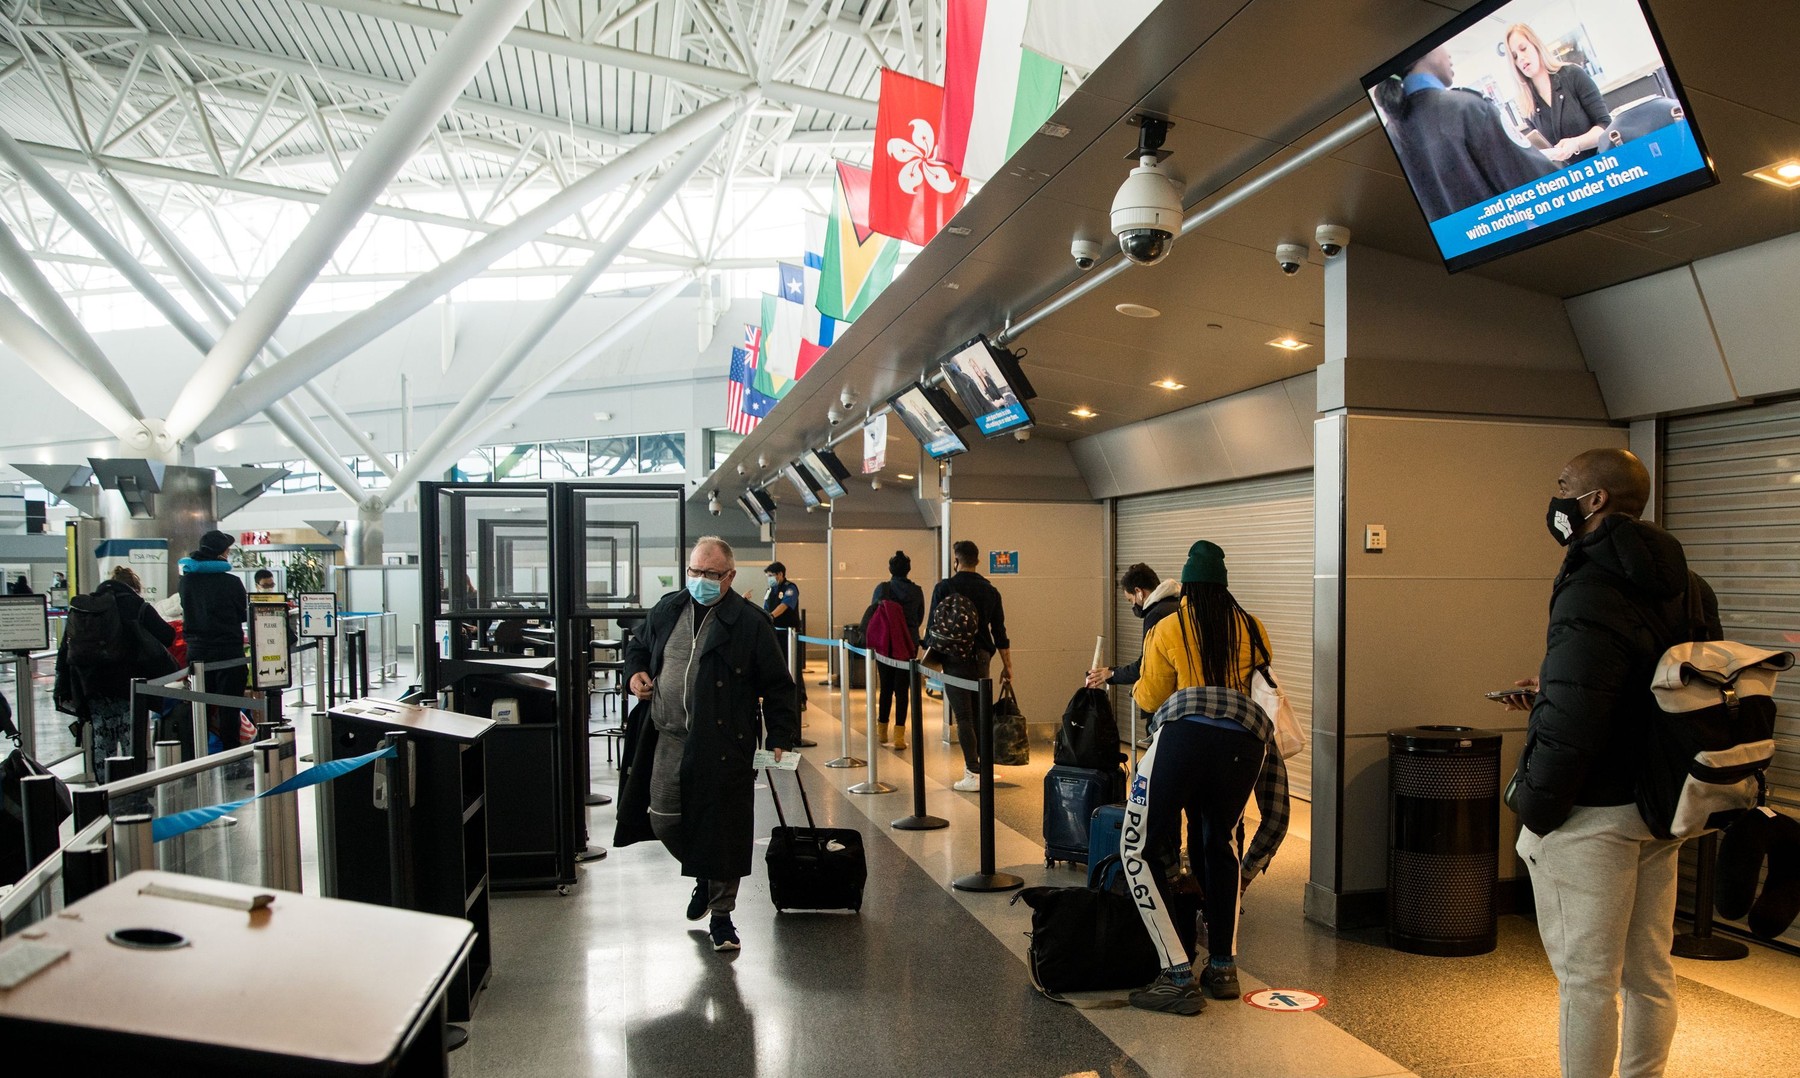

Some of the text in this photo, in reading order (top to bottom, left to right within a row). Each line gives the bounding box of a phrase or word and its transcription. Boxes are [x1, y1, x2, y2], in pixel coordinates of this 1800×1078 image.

[1466, 165, 1648, 240] with nothing on or under them.
[1505, 189, 1536, 211] place
[1536, 175, 1569, 196] them
[1568, 169, 1584, 183] in
[1584, 165, 1595, 177] a
[1593, 156, 1619, 173] bin
[1124, 809, 1156, 911] POLO-67
